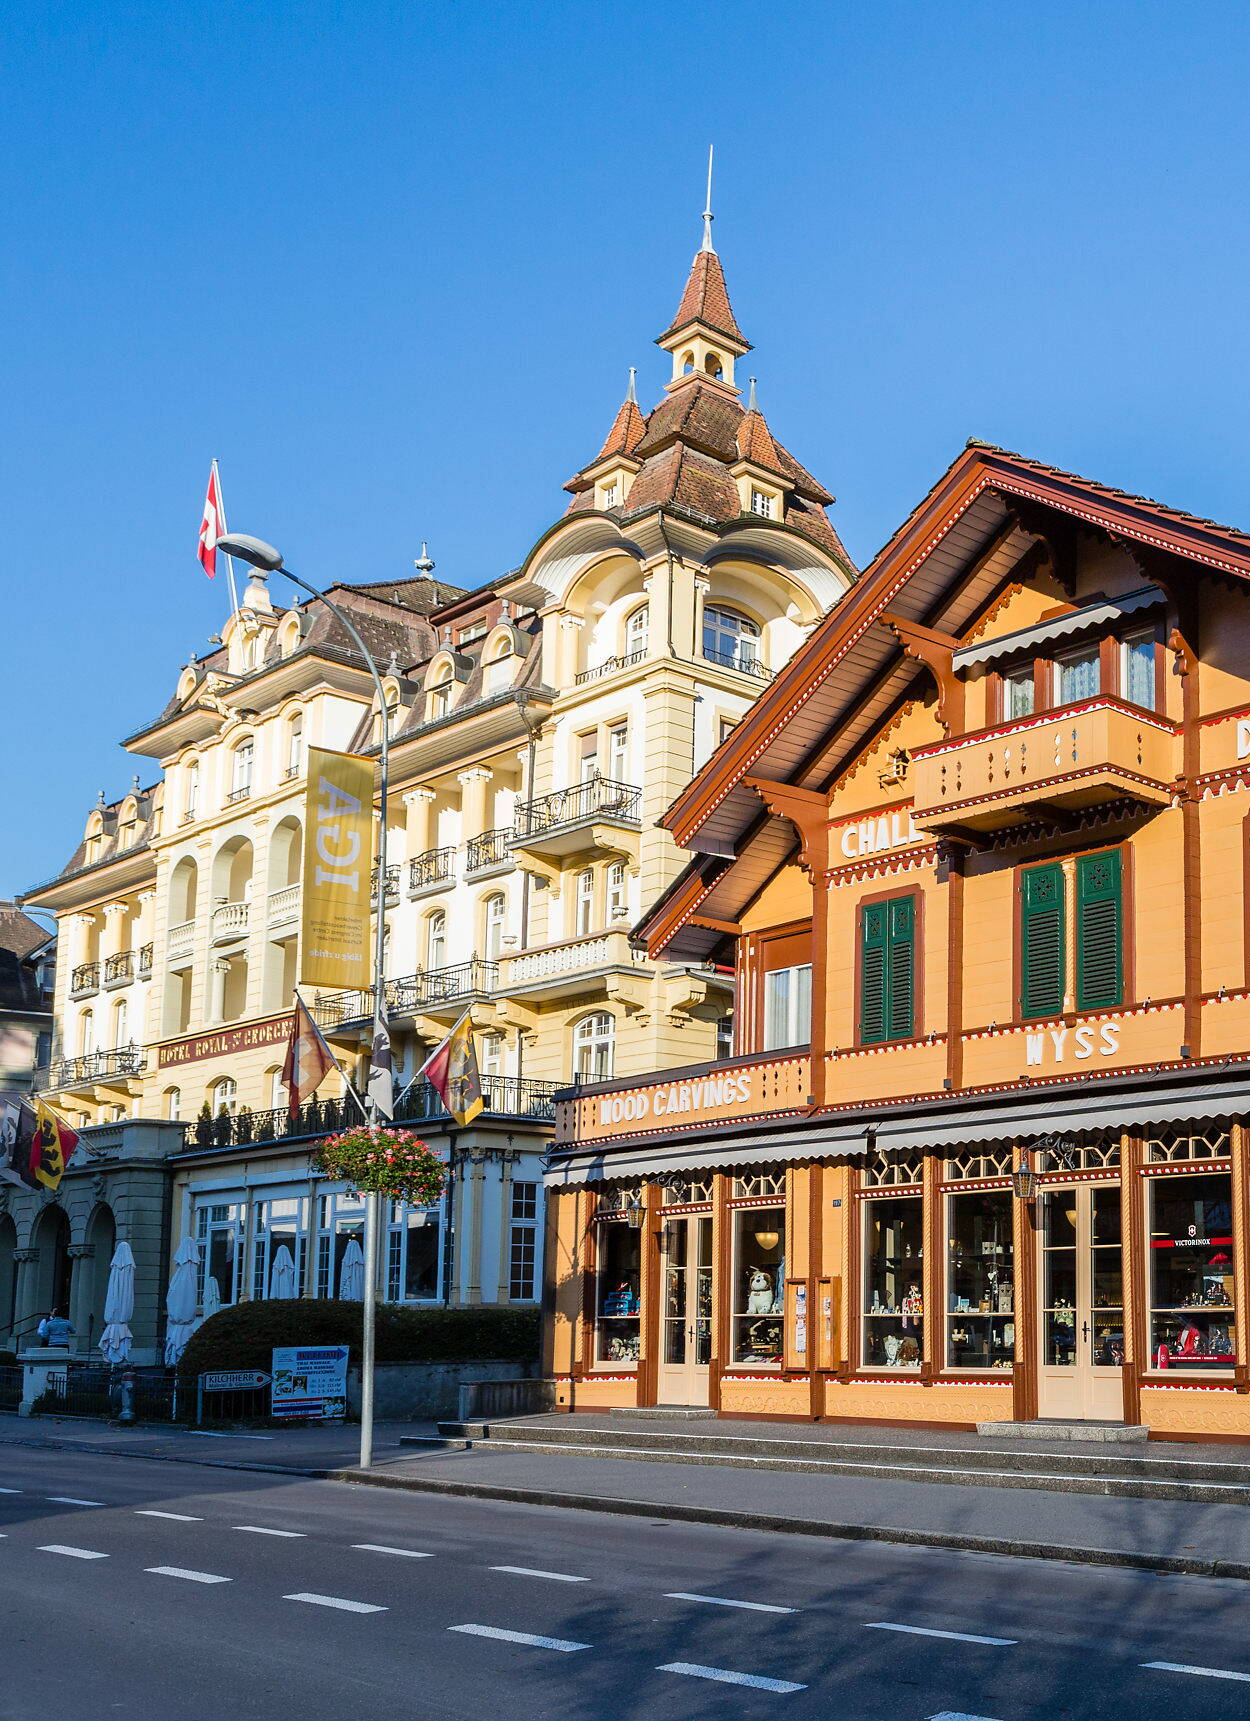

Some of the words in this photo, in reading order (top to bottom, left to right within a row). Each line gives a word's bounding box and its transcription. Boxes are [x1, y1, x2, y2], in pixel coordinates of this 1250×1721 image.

[1026, 1022, 1120, 1066] WYSS
[600, 1093, 650, 1126] WOOD
[653, 1075, 752, 1117] CARVINGS
[1174, 1238, 1211, 1246] VICTORINOX
[209, 1373, 254, 1383] KILCHHERR
